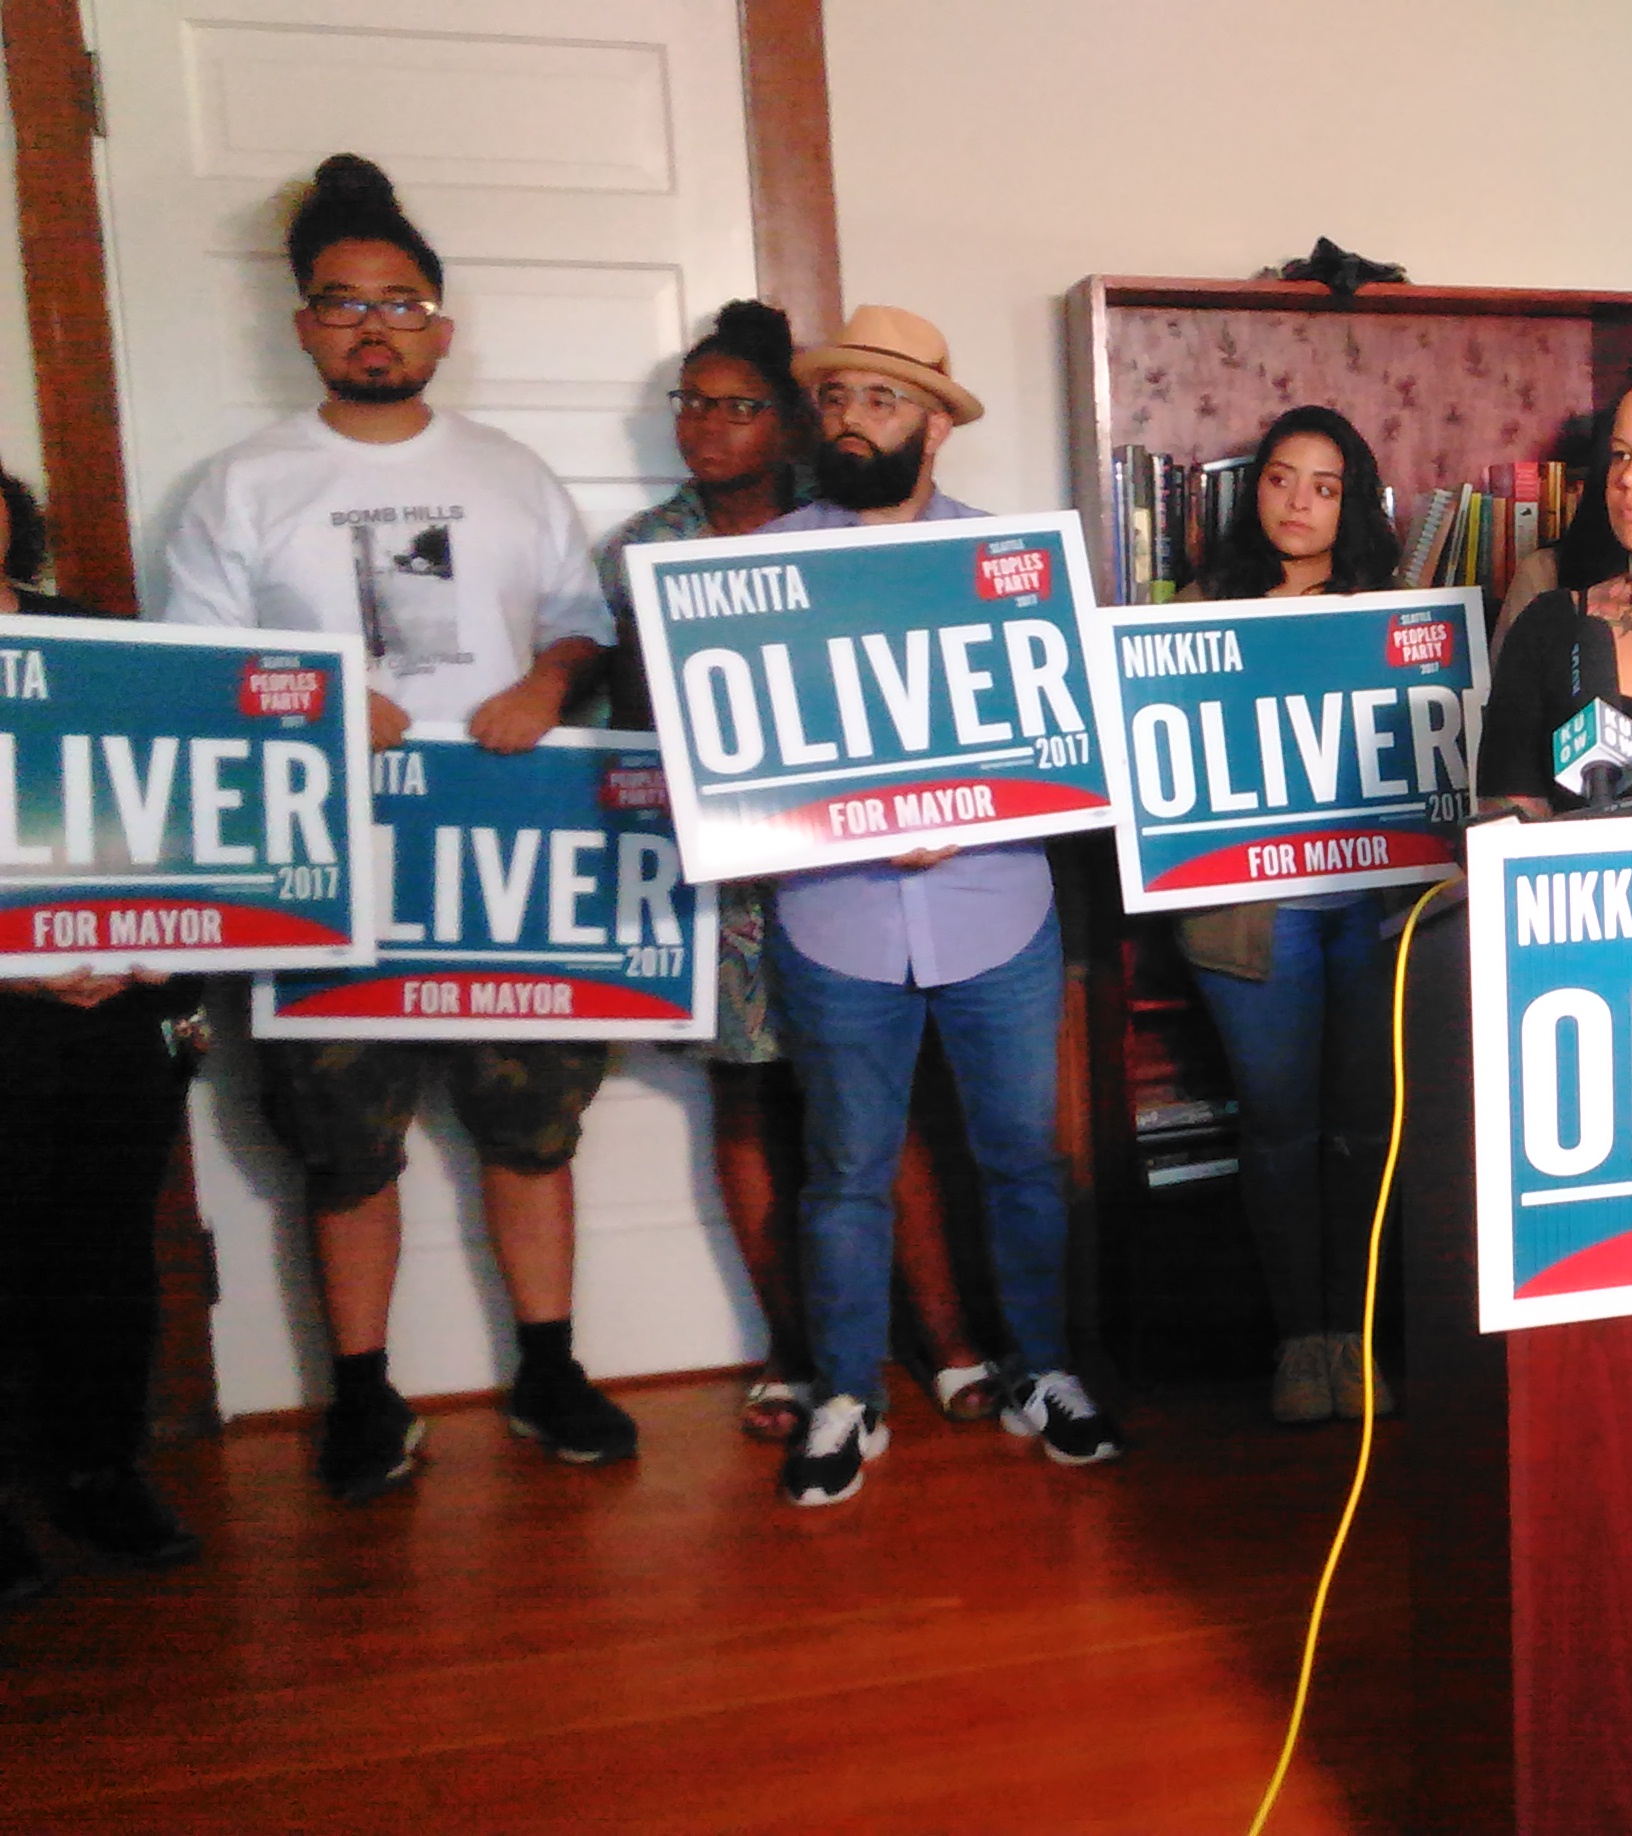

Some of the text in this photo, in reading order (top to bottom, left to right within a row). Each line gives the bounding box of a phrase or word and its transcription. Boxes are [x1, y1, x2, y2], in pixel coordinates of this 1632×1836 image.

[330, 505, 465, 526] BOMB HILLS
[981, 552, 1044, 580] PEOPLES
[994, 571, 1040, 595] PARTY
[665, 565, 811, 621] NIKKITA
[1121, 629, 1244, 678] NIKKITA
[1393, 624, 1447, 649] PEOPLES
[1402, 641, 1442, 663] PARTY
[683, 618, 1085, 775] OLIVER
[1035, 733, 1090, 770] 2017
[1132, 685, 1470, 818] OLIVER
[0, 733, 338, 865] LIVER
[828, 785, 996, 838] FOR MAYOR
[1429, 792, 1468, 823] 201
[1248, 835, 1389, 878] FOR MAYOR
[278, 866, 339, 901] 2017
[372, 823, 684, 945] LIVER
[33, 908, 222, 947] FOR MAYOR
[625, 946, 684, 977] 2017
[403, 980, 573, 1014] FOR MAYOR
